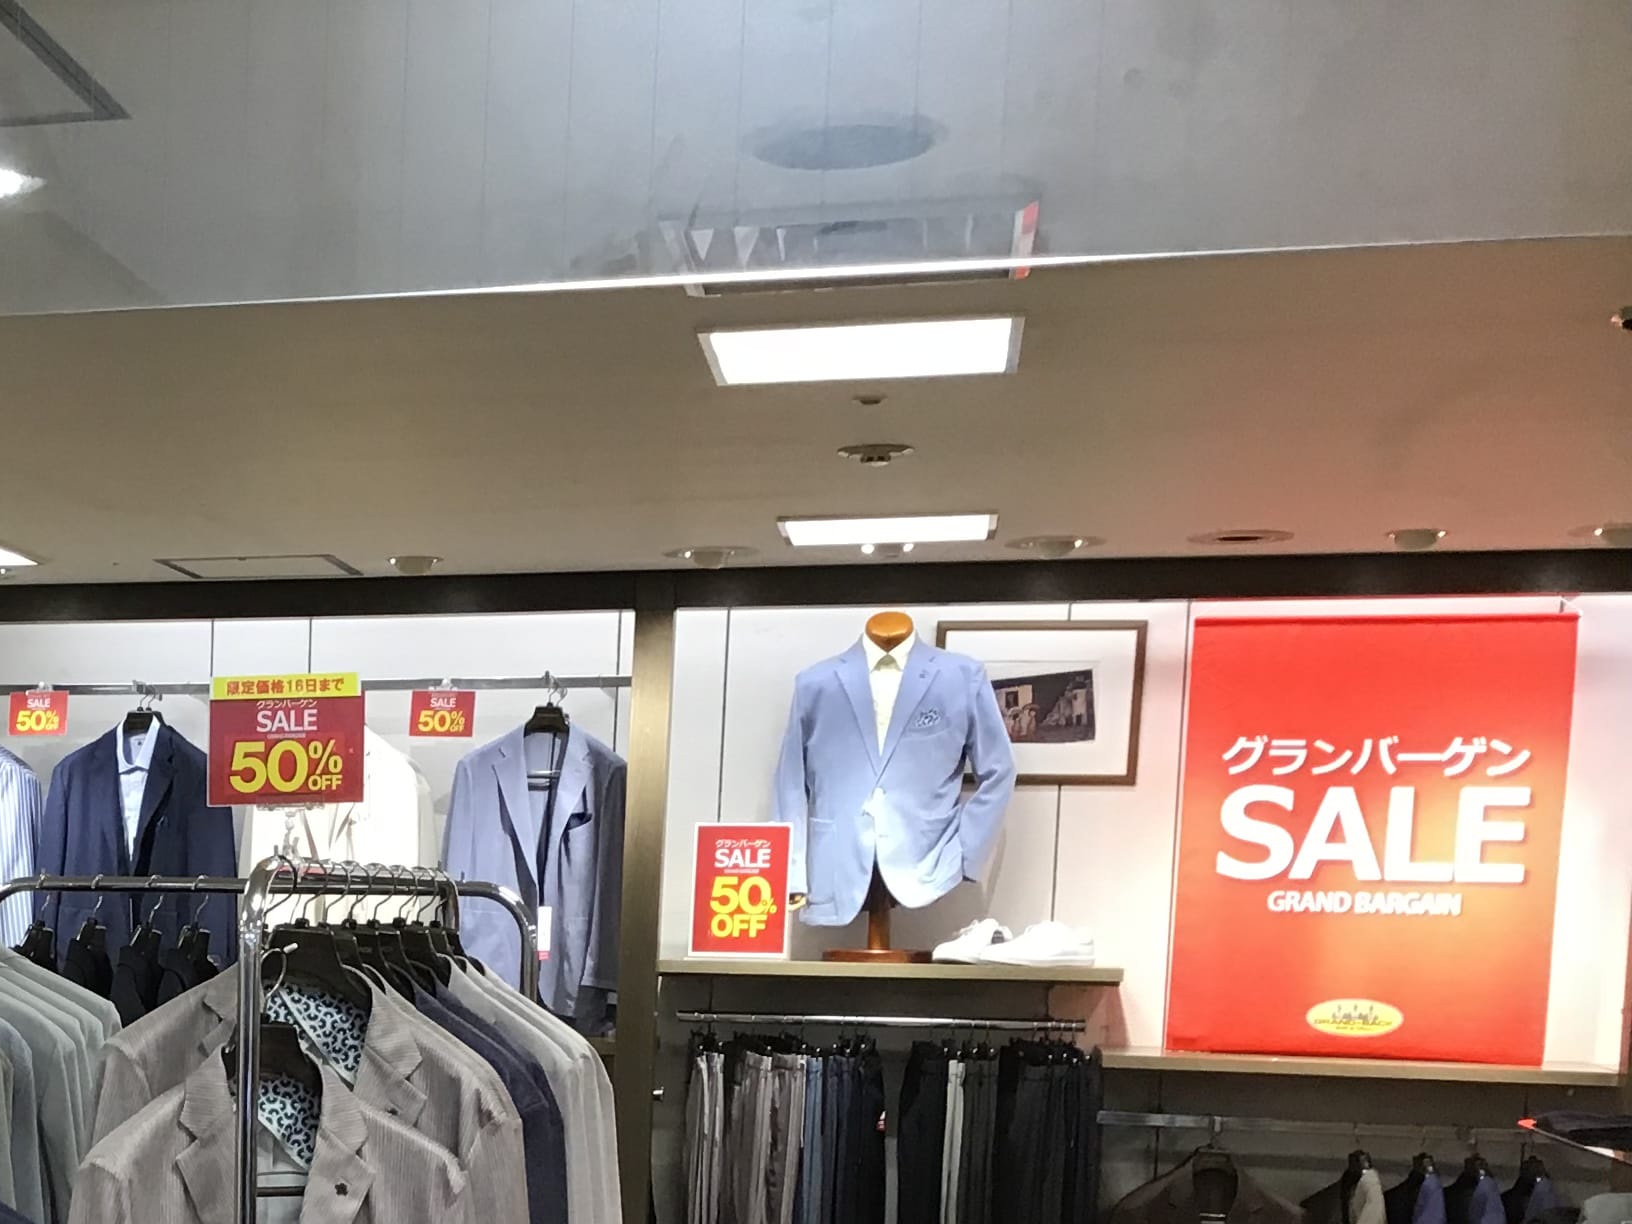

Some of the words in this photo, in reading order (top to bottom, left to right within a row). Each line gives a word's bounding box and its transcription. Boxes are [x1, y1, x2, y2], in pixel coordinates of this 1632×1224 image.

[226, 678, 345, 696] 限定価格16日まで
[27, 698, 51, 708] SALE
[430, 697, 457, 708] SALE
[15, 710, 59, 732] 50%
[256, 708, 318, 732] SALE
[418, 710, 465, 732] 50%
[229, 739, 343, 793] 50%
[1222, 735, 1531, 777] グランバーゲン
[307, 775, 343, 791] OFF
[1215, 784, 1532, 884] SALE
[714, 849, 771, 868] SALE
[710, 876, 777, 915] 50%
[1267, 889, 1352, 914] GRAND
[1353, 890, 1462, 917] BARGAIN
[710, 914, 768, 938] OFF
